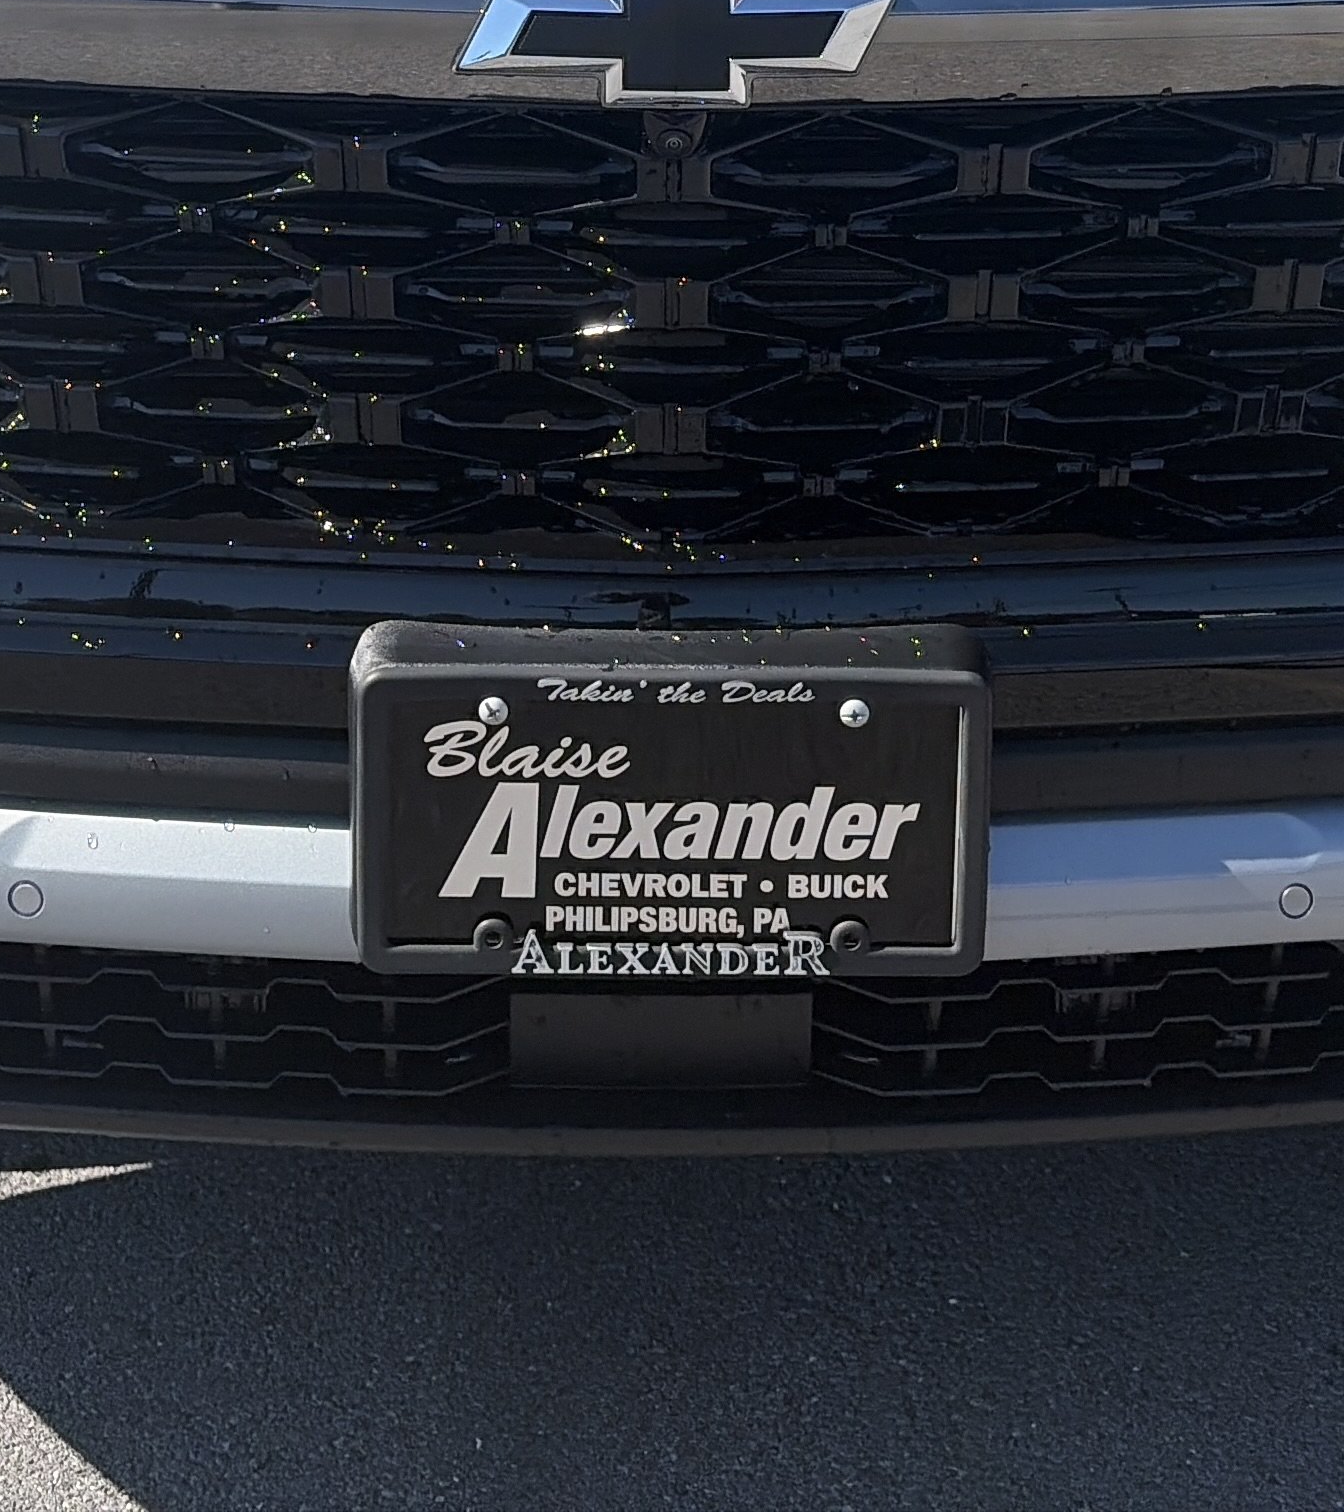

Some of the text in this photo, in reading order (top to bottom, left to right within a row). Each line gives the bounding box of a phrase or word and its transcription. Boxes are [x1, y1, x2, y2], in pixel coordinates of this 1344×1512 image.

[537, 677, 816, 704] Takin' the Deals
[423, 721, 630, 780] Blaise
[438, 782, 921, 900] Alexander
[554, 872, 889, 900] CHEVROLET BUICK
[545, 905, 792, 939] PHILIPSBURG, PA
